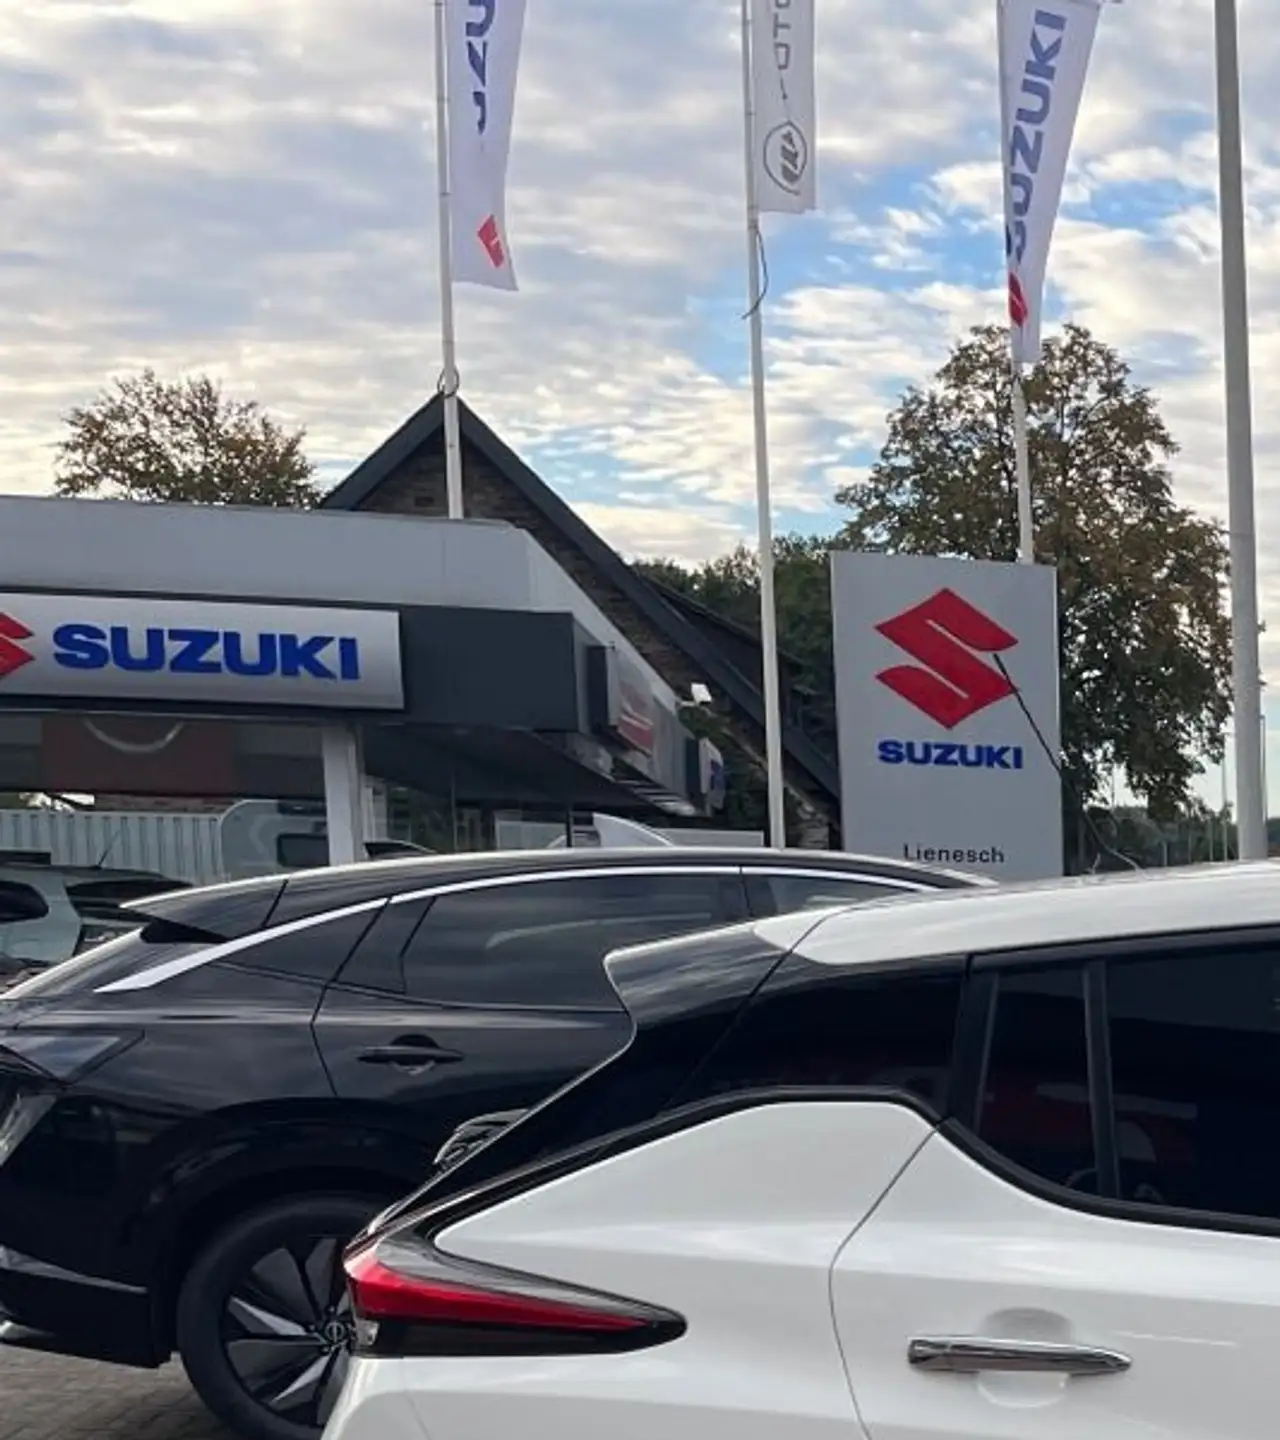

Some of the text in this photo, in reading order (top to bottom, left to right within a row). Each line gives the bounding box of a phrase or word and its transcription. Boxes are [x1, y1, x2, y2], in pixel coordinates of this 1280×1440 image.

[52, 623, 361, 680] SUZUKI
[877, 739, 1024, 769] SUZUKI
[904, 843, 1004, 863] Lienesch
